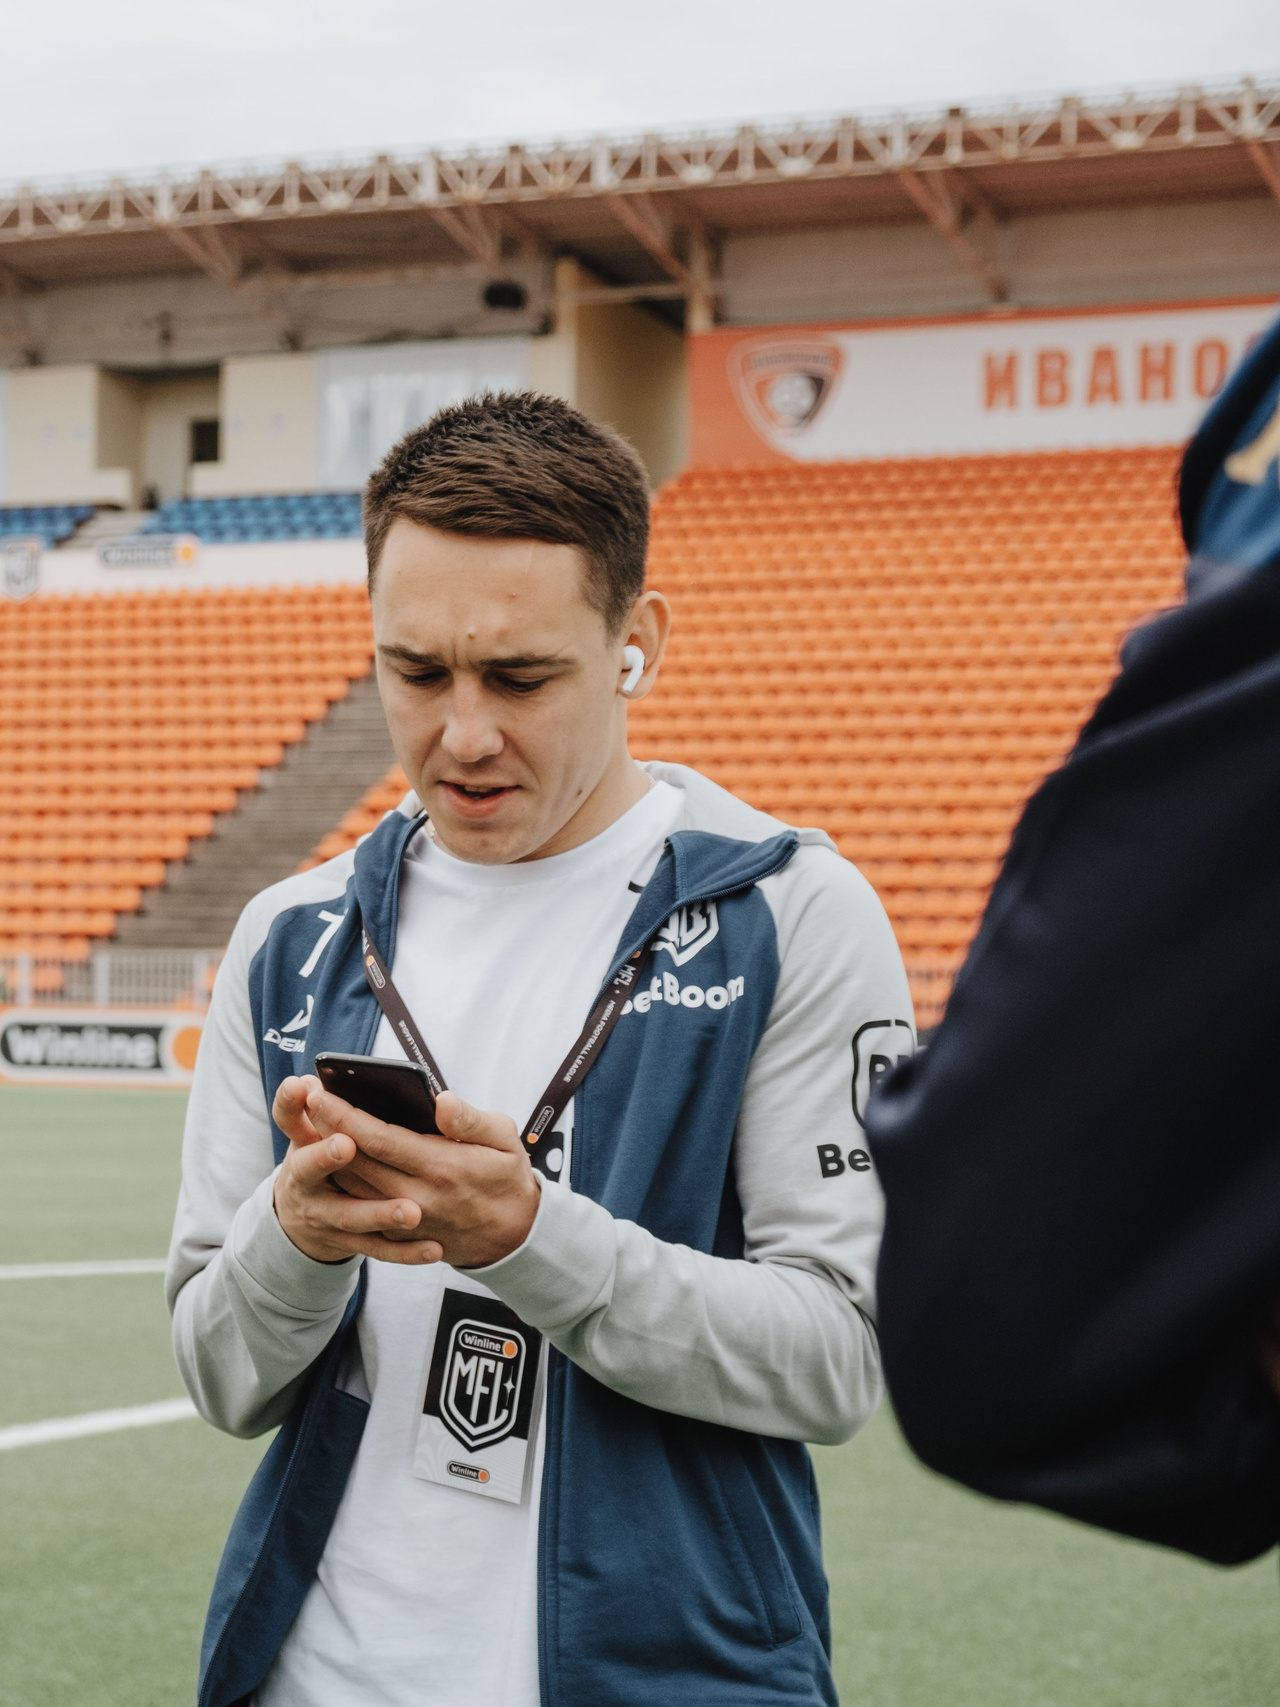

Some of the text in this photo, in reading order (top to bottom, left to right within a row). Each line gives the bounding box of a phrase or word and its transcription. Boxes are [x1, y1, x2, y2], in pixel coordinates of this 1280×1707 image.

[7, 1024, 157, 1068] Winline
[563, 999, 616, 1083] MEDIA FOOTBALL LEAGUE
[534, 1109, 552, 1133] Winline
[464, 1333, 502, 1352] Winline
[447, 1351, 509, 1436] MFL
[451, 1464, 478, 1478] Winline
